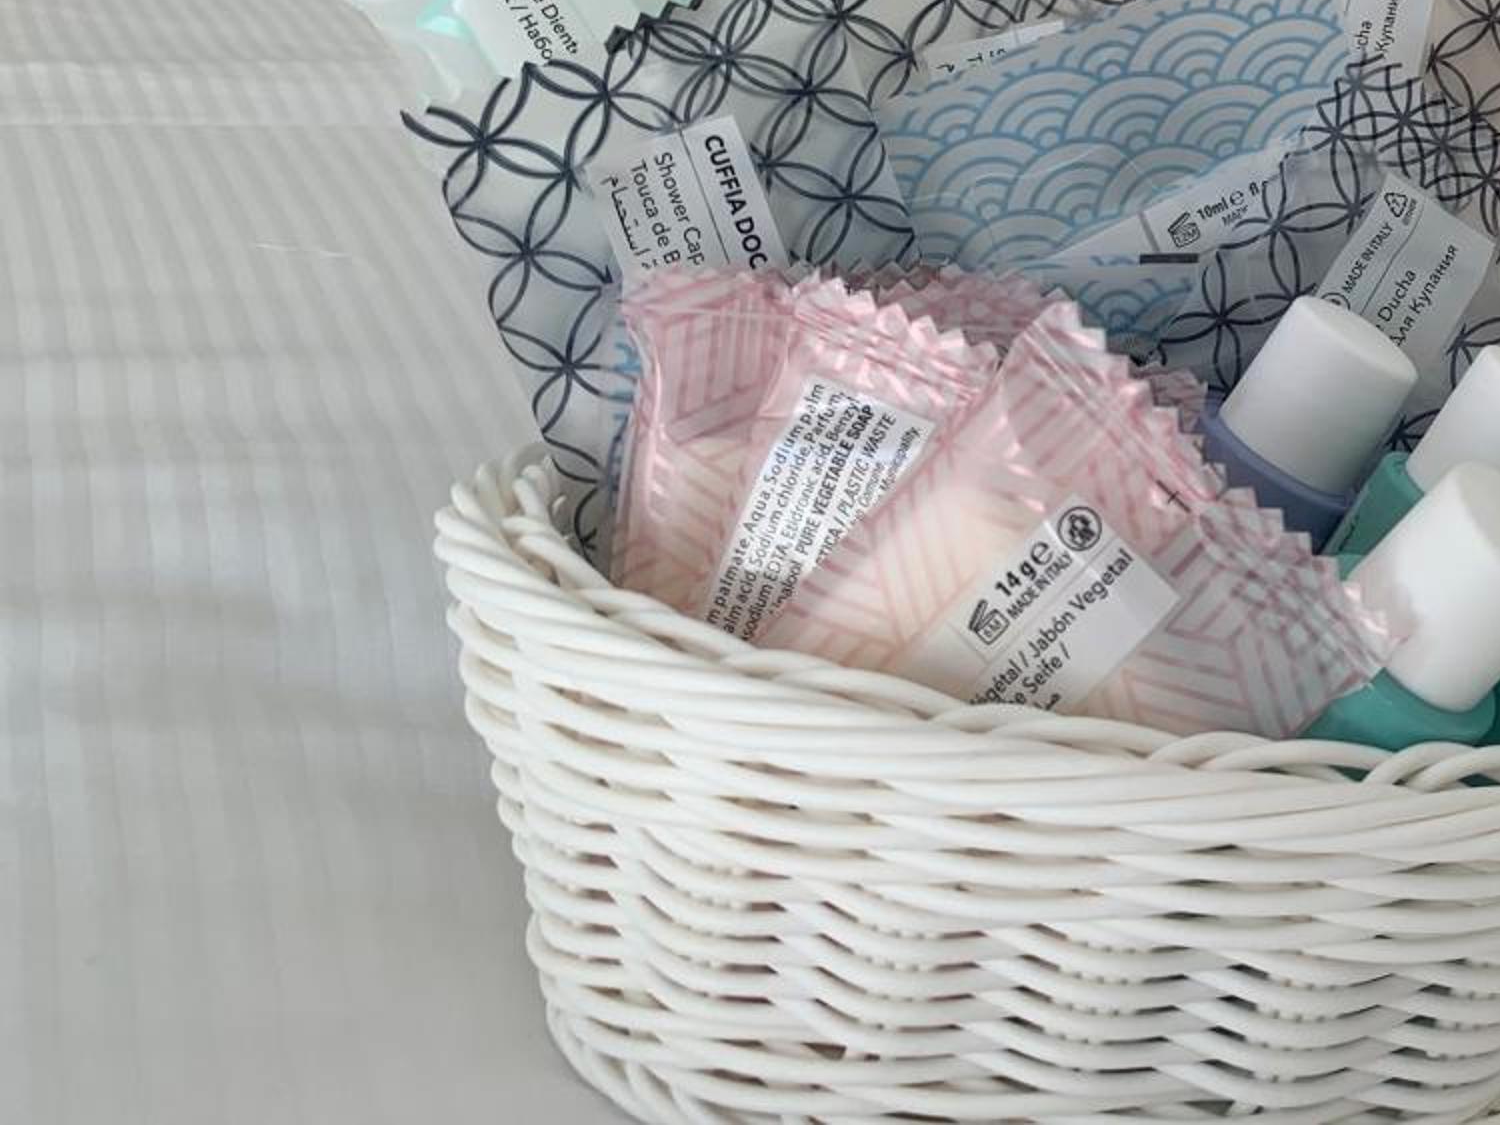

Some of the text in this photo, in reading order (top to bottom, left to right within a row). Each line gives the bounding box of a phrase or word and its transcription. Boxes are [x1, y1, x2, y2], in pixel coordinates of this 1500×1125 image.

[519, 14, 552, 60] Набо
[541, 4, 577, 54] Dient
[1355, 21, 1372, 52] cha
[631, 160, 658, 218] Touca
[652, 223, 671, 247] de
[654, 152, 690, 222] Shower
[705, 136, 768, 269] CUFFIA DOC
[1342, 223, 1392, 293] MADE IN ITALY
[1408, 245, 1456, 314] Купания
[1377, 271, 1416, 322] Ducha
[764, 424, 805, 484] Sodium
[795, 519, 820, 555] PURE
[812, 439, 854, 515] VEGETABLE
[846, 406, 873, 439] SOAP
[837, 459, 869, 517] PLASTIC
[863, 414, 896, 457] WASTE
[723, 605, 742, 633] alm
[749, 510, 783, 568] Sodium
[996, 572, 1021, 596] 14
[1007, 587, 1039, 619] MADE
[1035, 576, 1050, 590] IN
[1045, 554, 1072, 580] ITALY
[1029, 612, 1075, 658] Jabón
[1069, 548, 1133, 610] Vegetal
[740, 585, 772, 640] sodium
[1022, 657, 1062, 695] Seife
